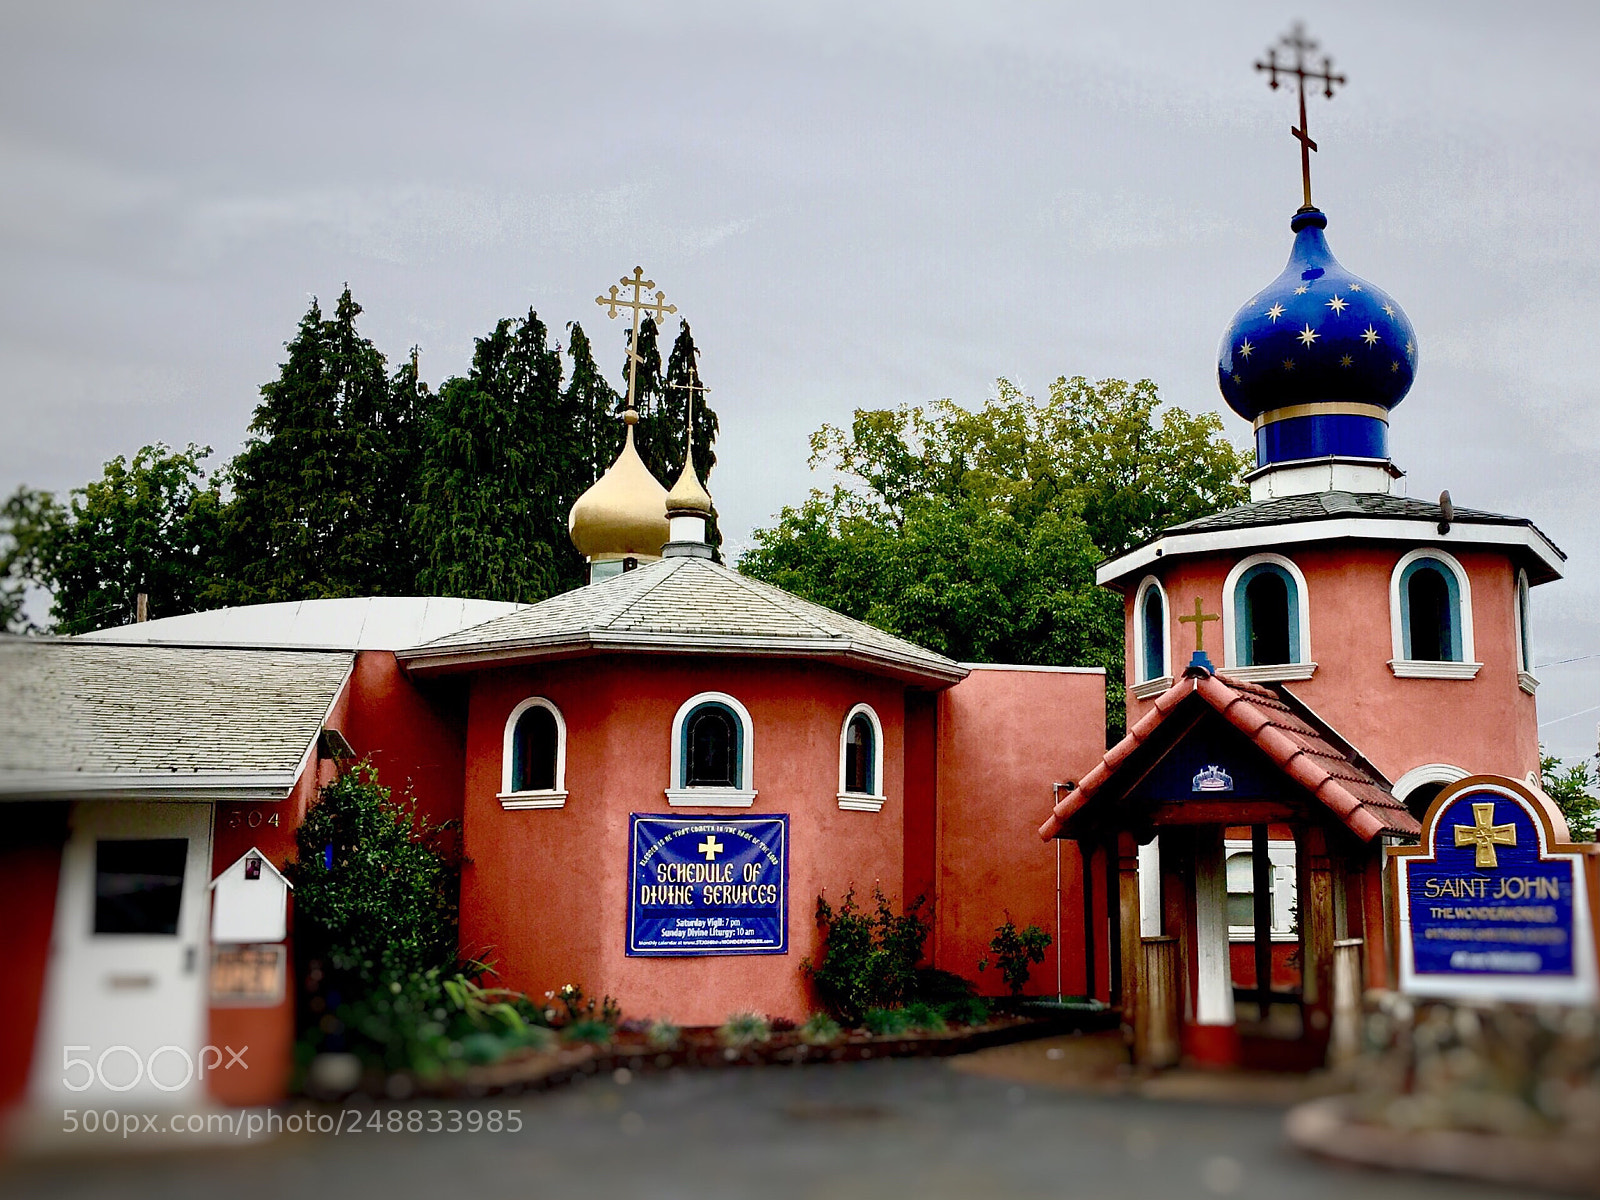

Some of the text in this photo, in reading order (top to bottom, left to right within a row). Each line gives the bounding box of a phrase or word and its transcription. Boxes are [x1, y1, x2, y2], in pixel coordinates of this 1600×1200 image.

[673, 827, 690, 837] THAT
[691, 825, 715, 833] COMETH
[725, 826, 737, 834] THE
[737, 830, 753, 841] NAME
[752, 837, 760, 845] OF
[760, 842, 770, 853] THE
[767, 852, 779, 865] LORD
[657, 863, 762, 883] SCHEDULE OF
[641, 884, 777, 905] DIVINE SERVICES
[1424, 876, 1560, 900] SAINT JOHN
[1430, 907, 1455, 919] THE
[661, 928, 686, 939] Sunday
[687, 928, 709, 937] Divine
[709, 927, 736, 938] Liturgy:
[736, 927, 745, 936] 10
[676, 918, 741, 929] Saturday Vigil: 7 pm
